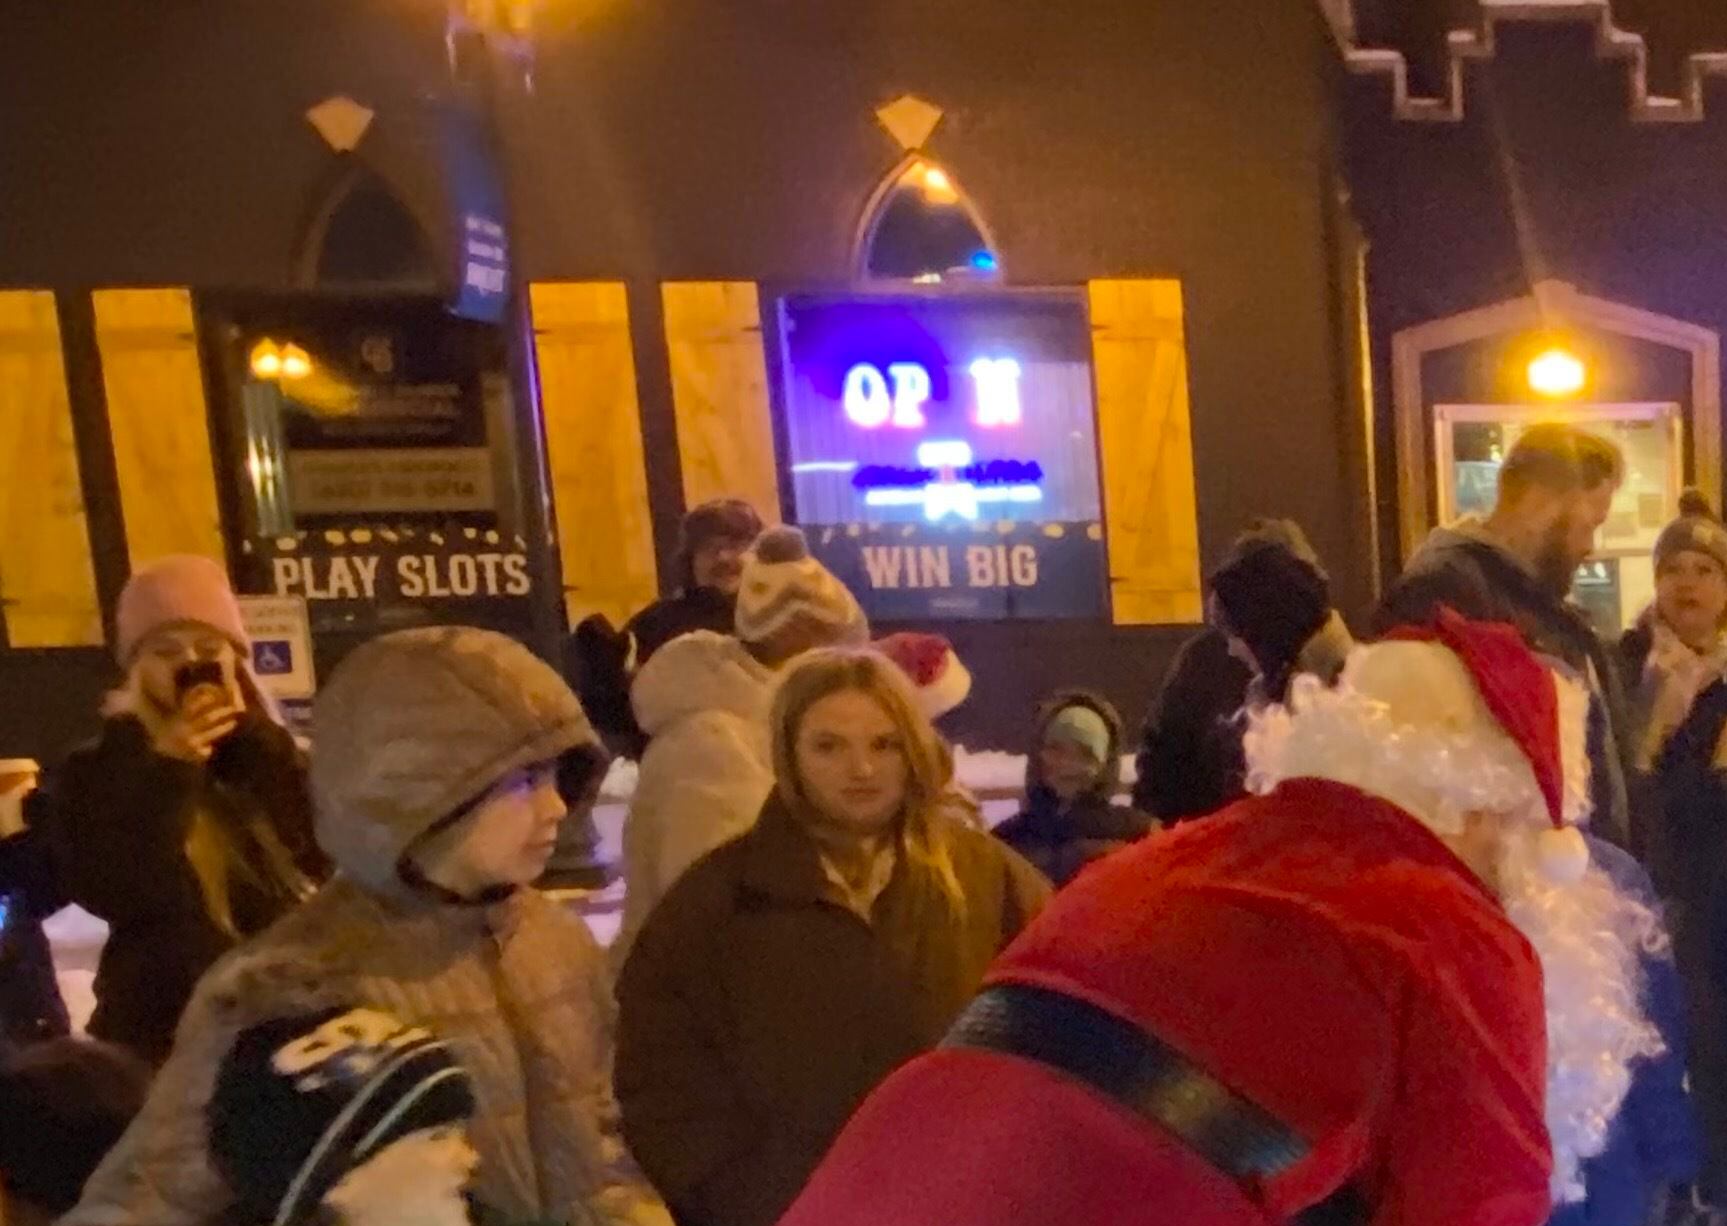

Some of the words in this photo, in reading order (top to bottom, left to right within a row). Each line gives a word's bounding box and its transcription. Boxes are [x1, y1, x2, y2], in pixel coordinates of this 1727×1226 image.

[845, 359, 1021, 428] OPN
[273, 557, 379, 599] PLAY
[397, 553, 530, 597] SLOTS
[862, 545, 950, 588] WIN
[966, 544, 1038, 587] BIG
